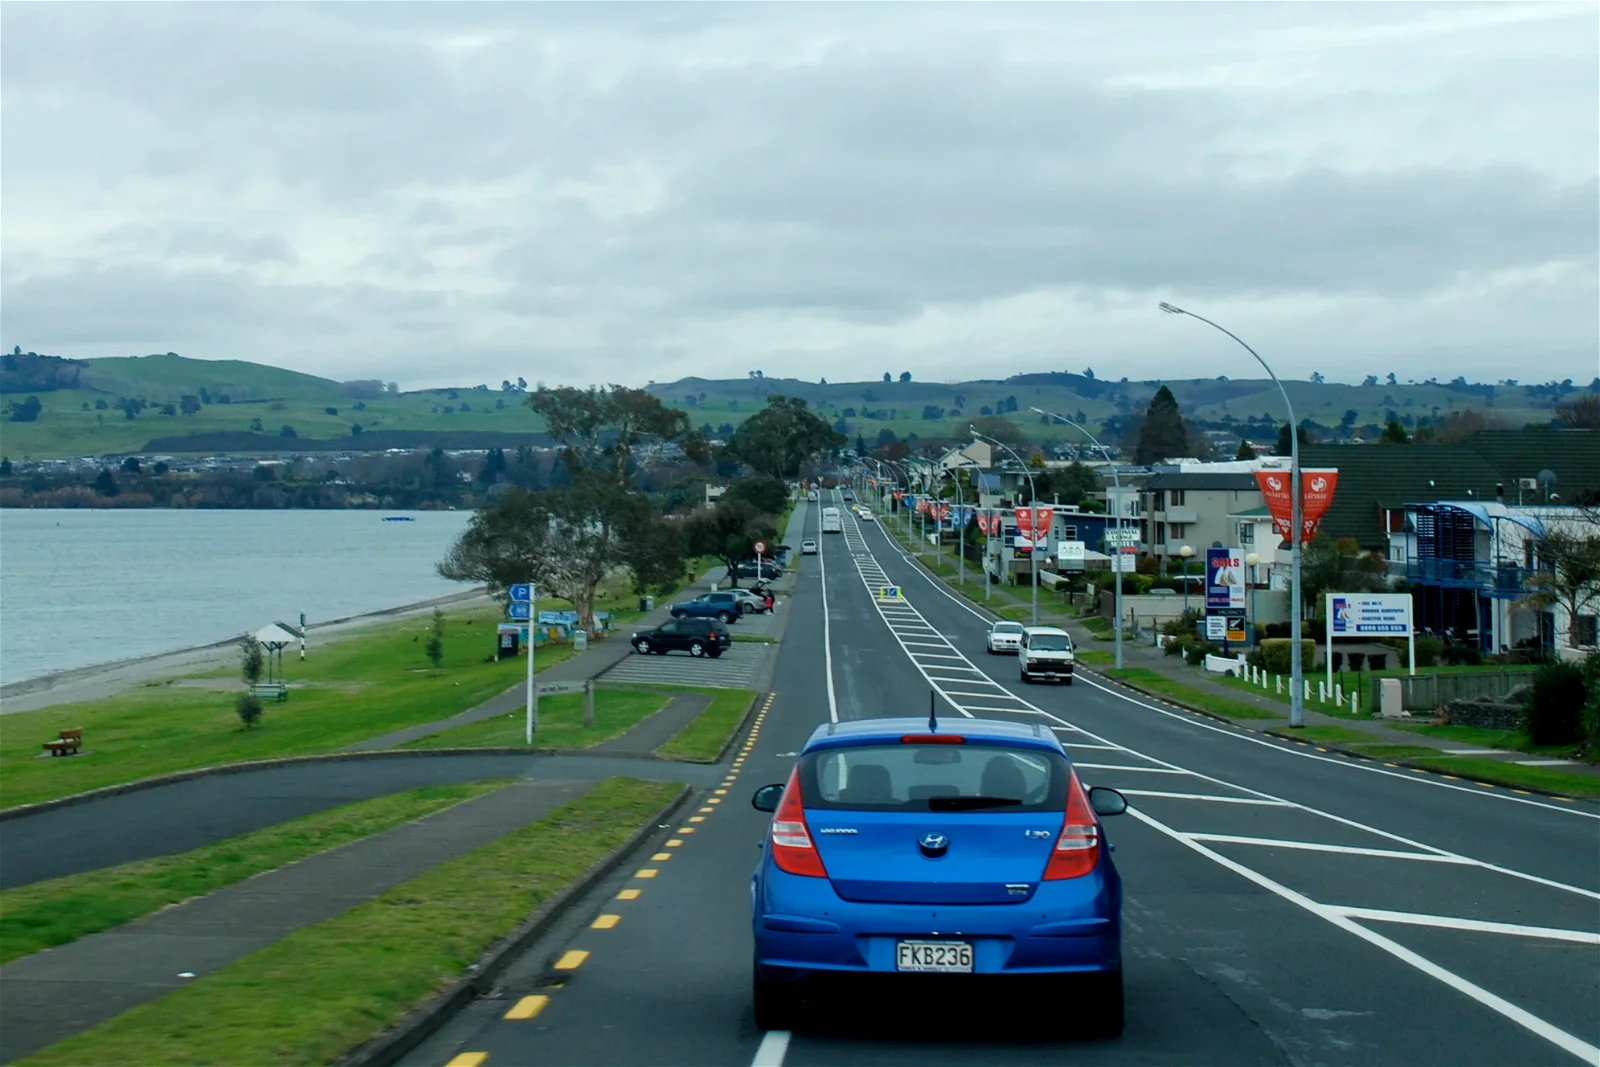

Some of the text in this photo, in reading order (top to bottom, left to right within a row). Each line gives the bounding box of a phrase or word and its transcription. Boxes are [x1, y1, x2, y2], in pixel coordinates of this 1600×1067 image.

[1211, 557, 1240, 568] SAILS
[518, 588, 527, 598] P
[900, 946, 970, 966] FKB236
